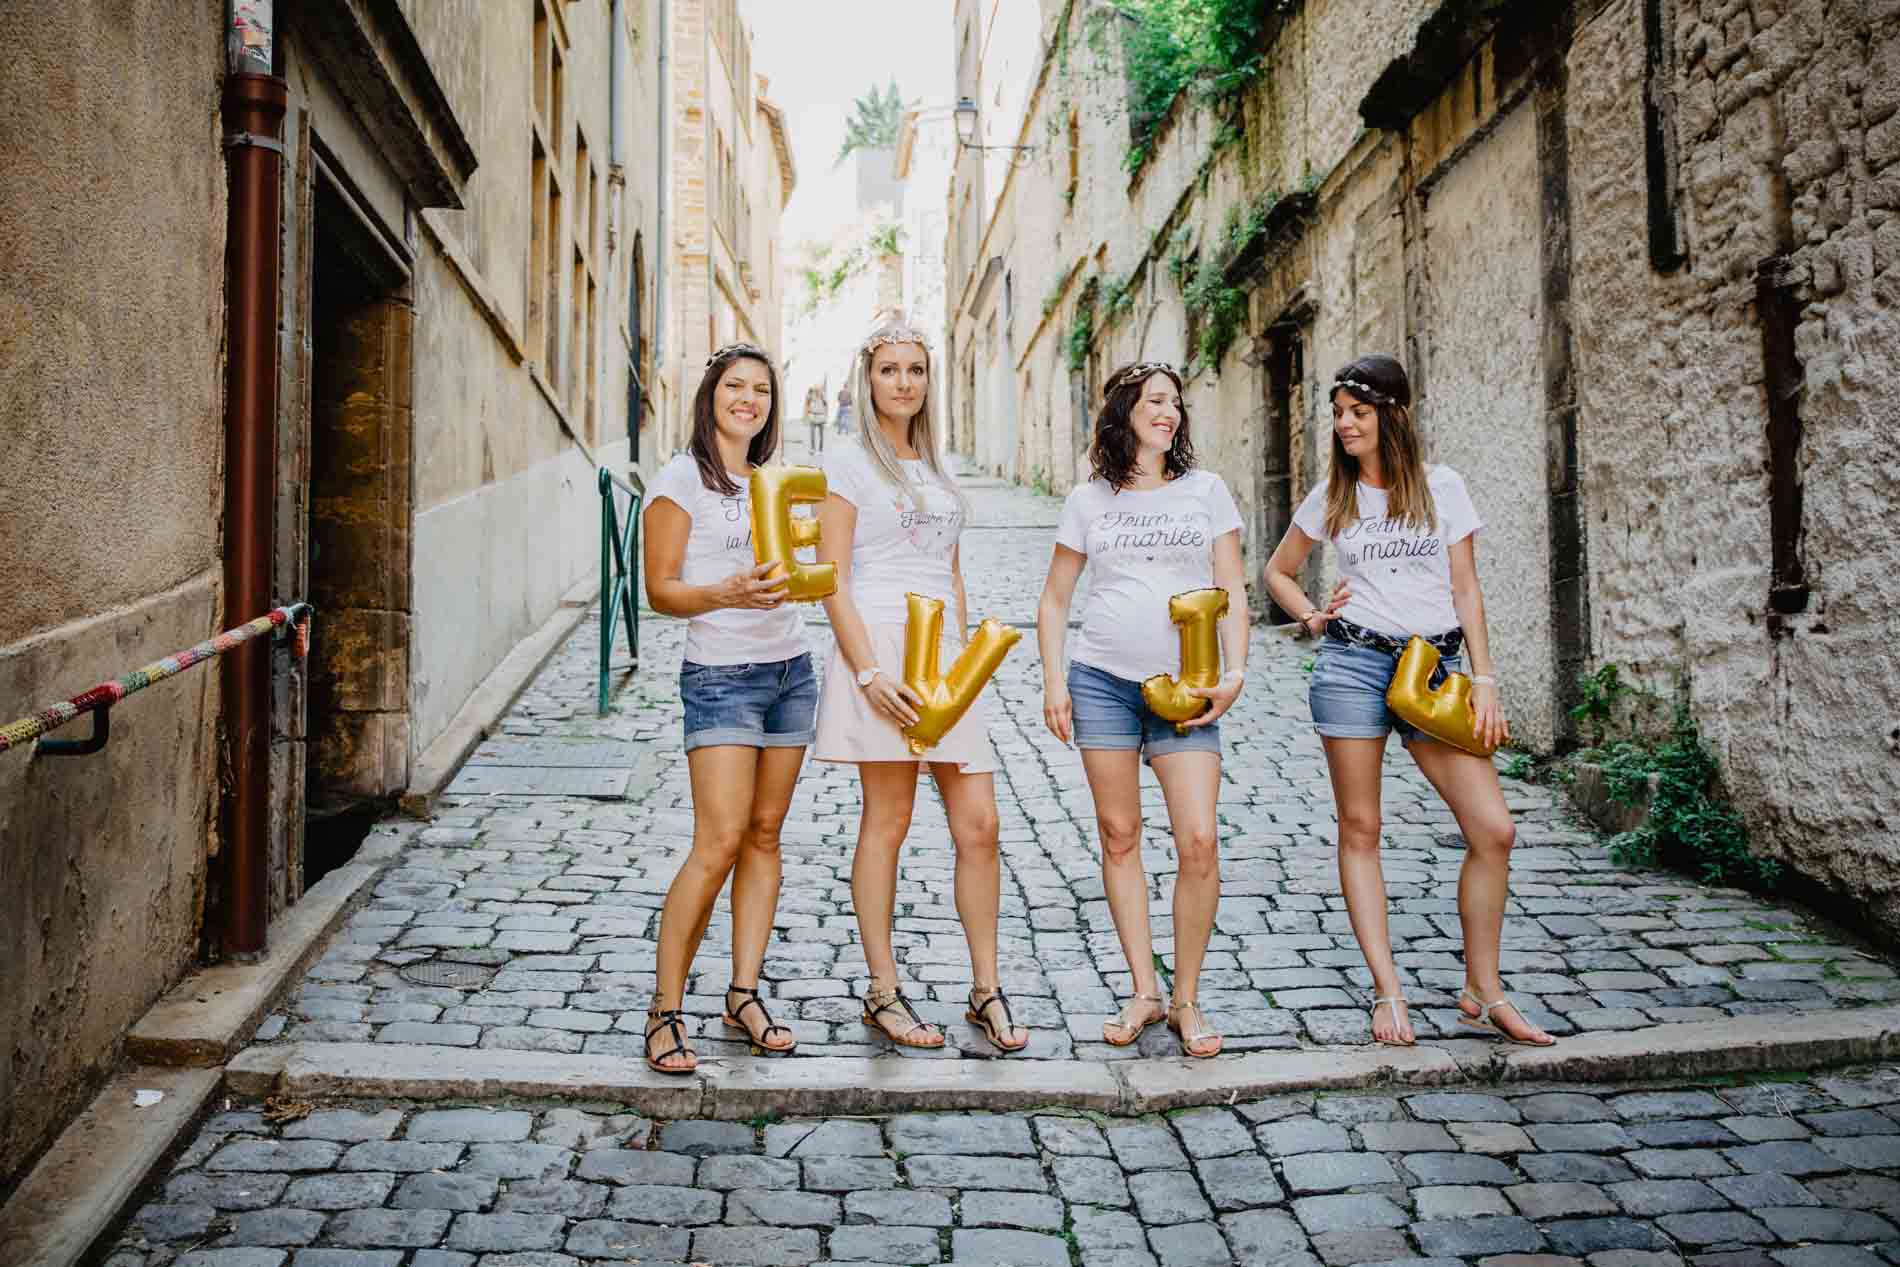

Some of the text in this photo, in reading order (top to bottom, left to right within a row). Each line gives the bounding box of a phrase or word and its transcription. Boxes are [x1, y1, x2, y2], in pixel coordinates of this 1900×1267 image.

[751, 464, 838, 603] E
[1114, 526, 1205, 550] mariée
[1363, 532, 1440, 562] mariée
[903, 592, 1020, 757] V
[1141, 587, 1230, 722] J
